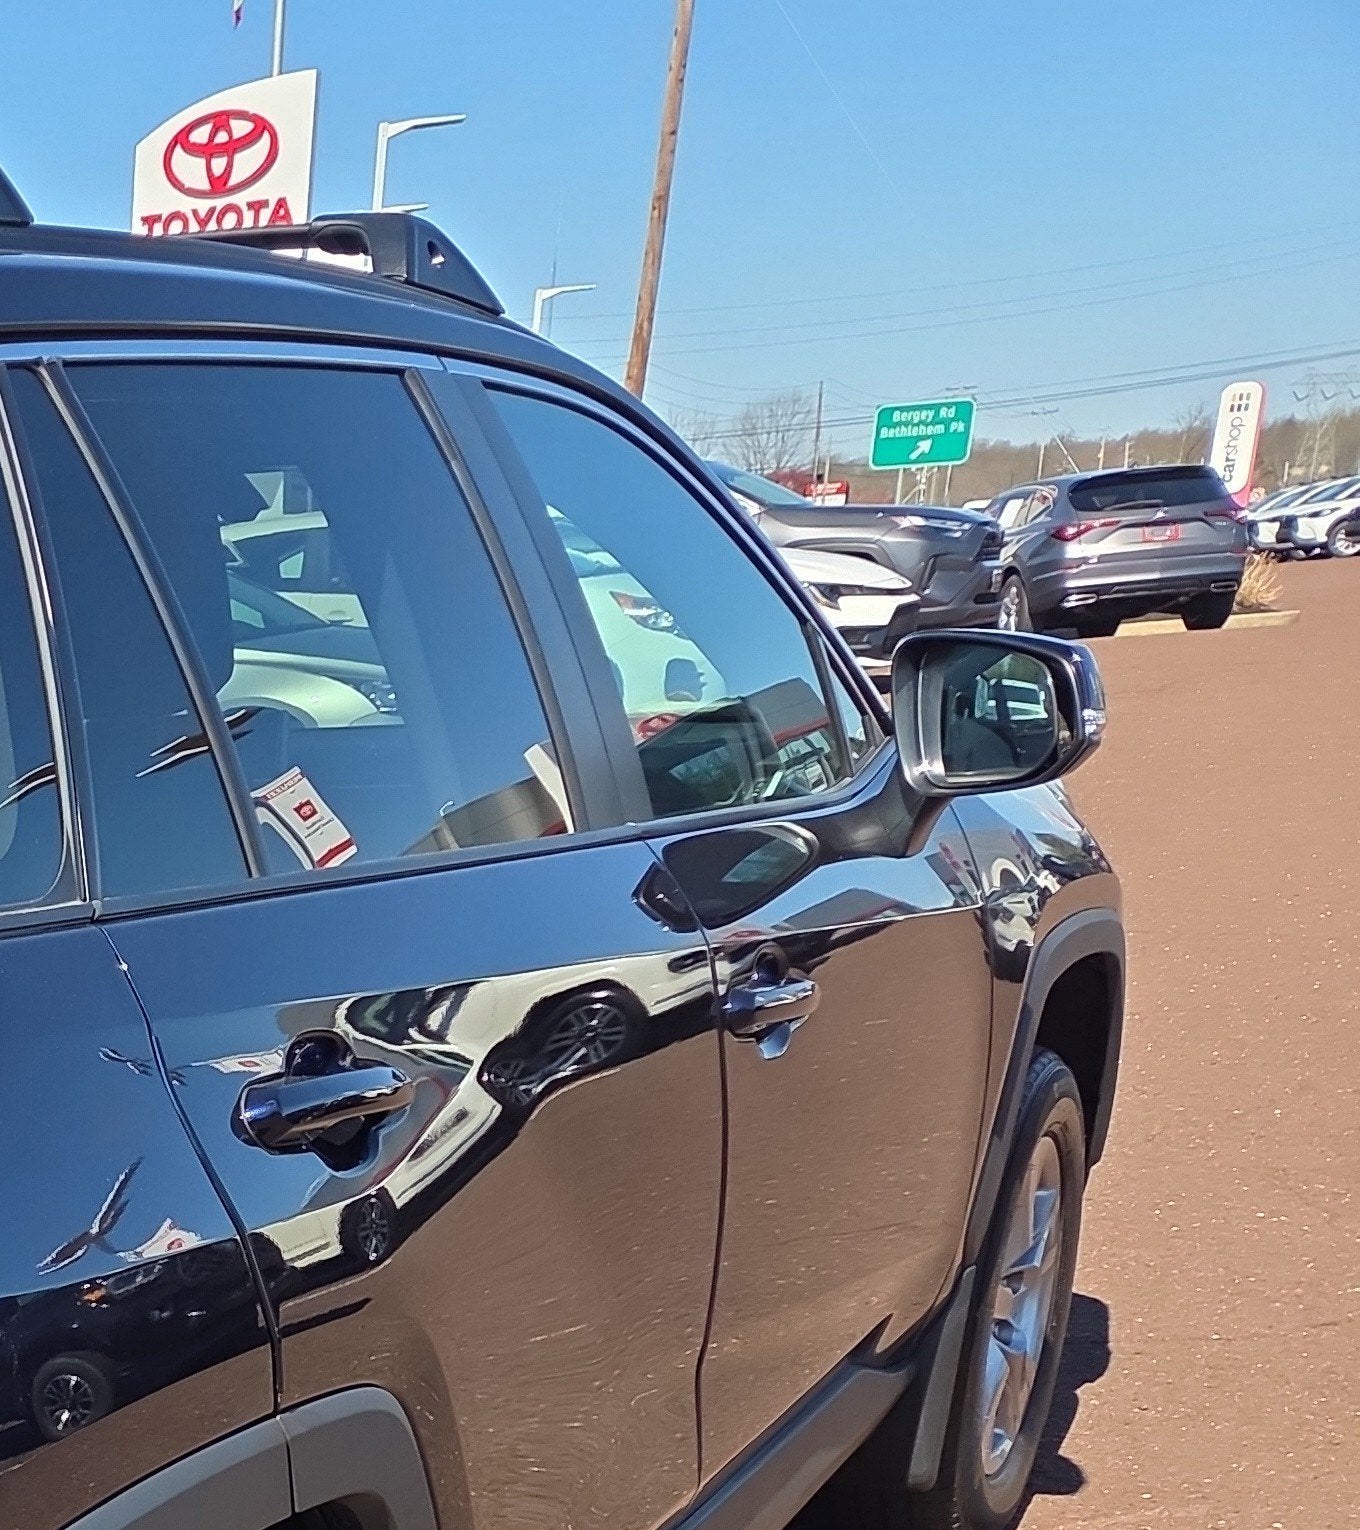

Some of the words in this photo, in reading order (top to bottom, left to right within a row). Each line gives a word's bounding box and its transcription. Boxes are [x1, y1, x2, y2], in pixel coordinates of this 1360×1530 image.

[141, 197, 294, 238] TOYOTA
[893, 409, 935, 423] Bergey
[940, 405, 956, 418] Rd
[880, 424, 945, 438] Bethlehem
[950, 420, 965, 433] Pk
[1222, 417, 1246, 482] carshop
